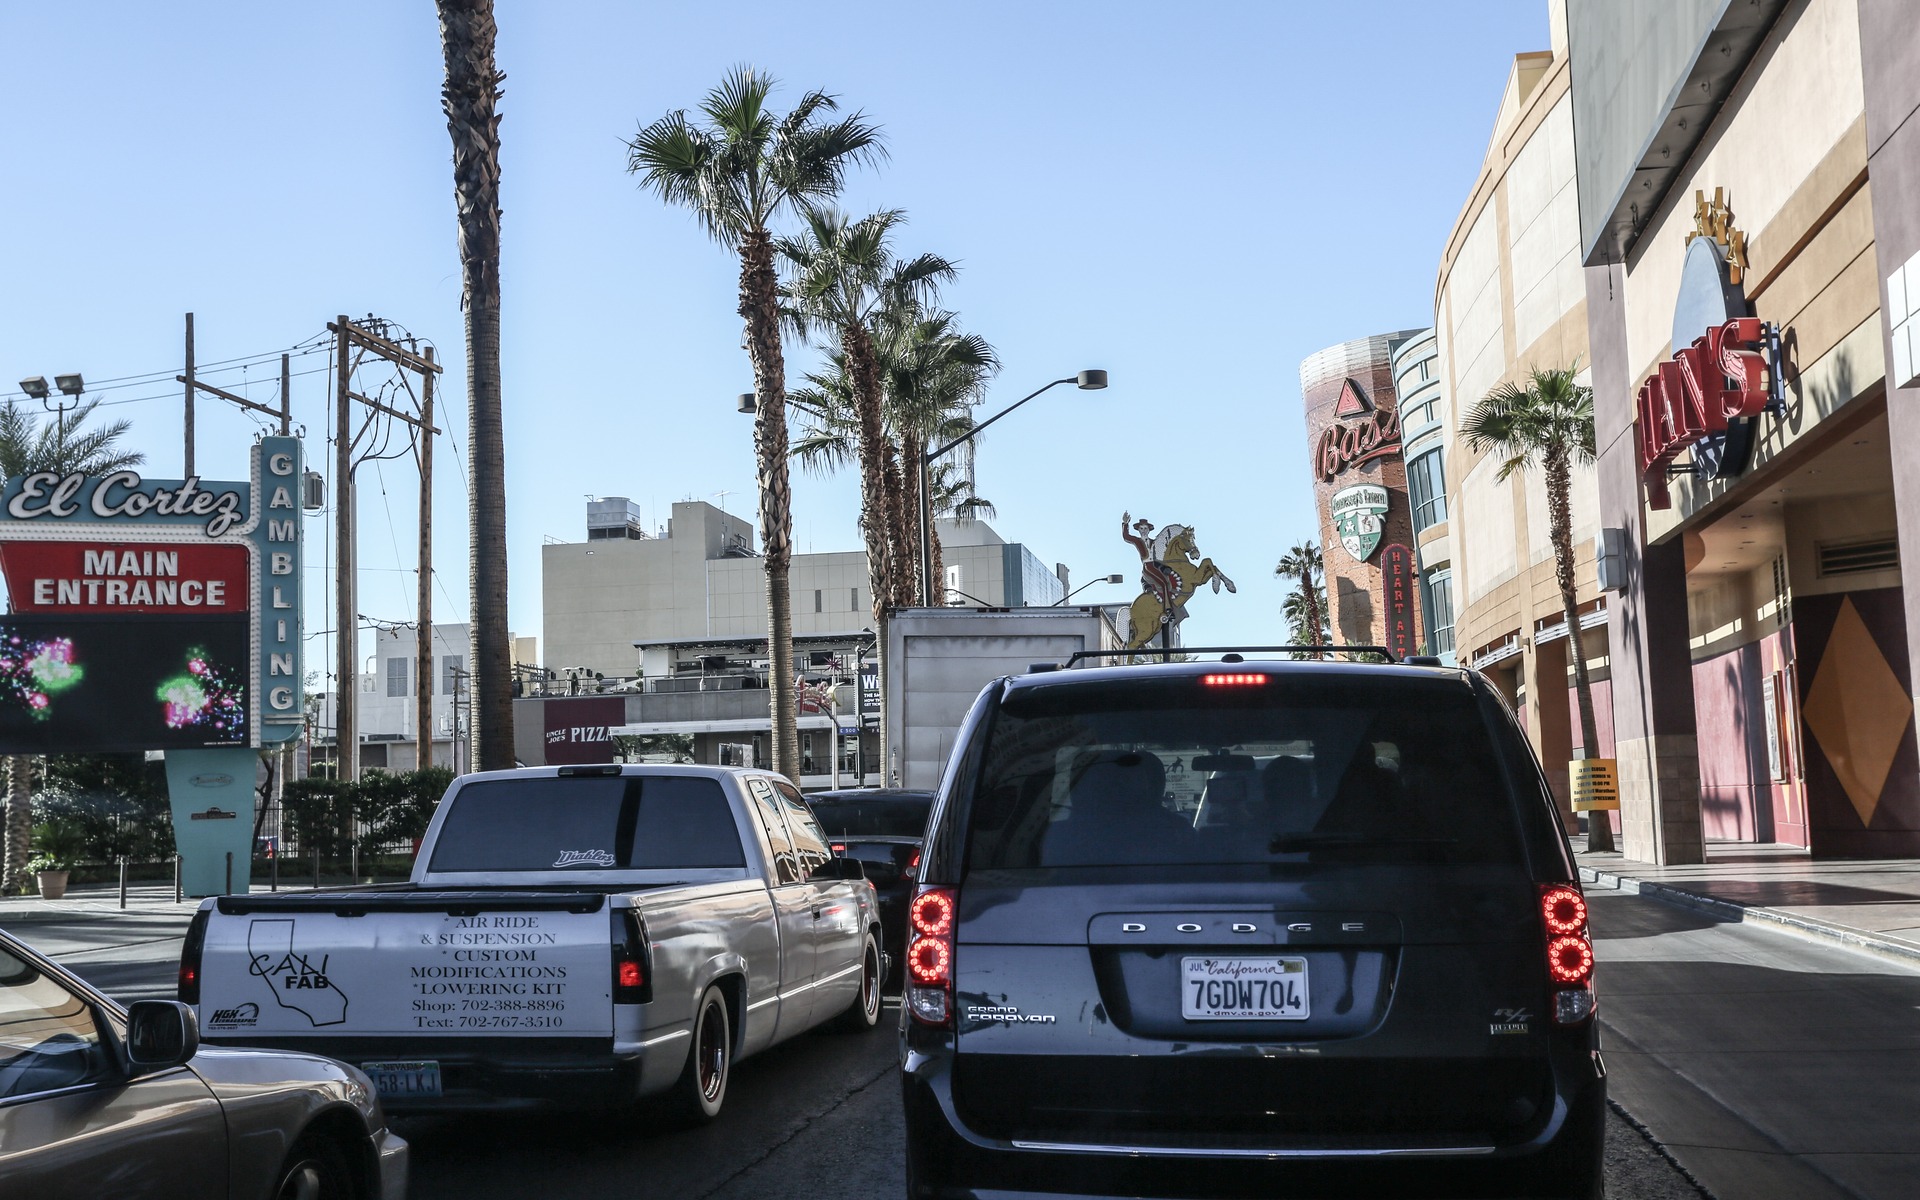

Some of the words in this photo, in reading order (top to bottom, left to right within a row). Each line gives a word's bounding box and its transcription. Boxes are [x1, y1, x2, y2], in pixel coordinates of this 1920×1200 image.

[1315, 404, 1401, 483] Bass
[8, 470, 85, 519] El
[91, 470, 243, 538] Cortez
[84, 550, 178, 576] MAIN
[269, 454, 295, 710] GAMBLING
[1392, 551, 1404, 614] HEART
[34, 578, 226, 606] ENTRANCE
[1396, 621, 1406, 658] ATT
[862, 674, 879, 690] Wi
[546, 729, 566, 738] UNCLE
[548, 735, 566, 744] JOE'S
[571, 726, 614, 743] PIZZA
[455, 916, 488, 928] AIR
[494, 916, 539, 928] RIDE
[1122, 922, 1364, 932] DODGE
[421, 933, 433, 945] &
[438, 933, 557, 945] SUSPENSION
[454, 950, 537, 962] CUSTOM
[249, 953, 329, 976] CALI
[411, 966, 567, 978] MODIFICATIONS
[1189, 962, 1204, 971] JUL
[1208, 960, 1282, 979] California
[285, 976, 329, 989] FAB
[532, 983, 567, 995] KIT
[1190, 980, 1301, 1009] 7GDW704
[412, 999, 455, 1013] Shop:
[461, 1000, 565, 1011] 702-388-8896
[413, 1016, 453, 1028] Text:
[459, 1016, 563, 1028] 702-767-3510
[1494, 1007, 1534, 1022] R/T
[383, 1063, 421, 1071] NEVADA
